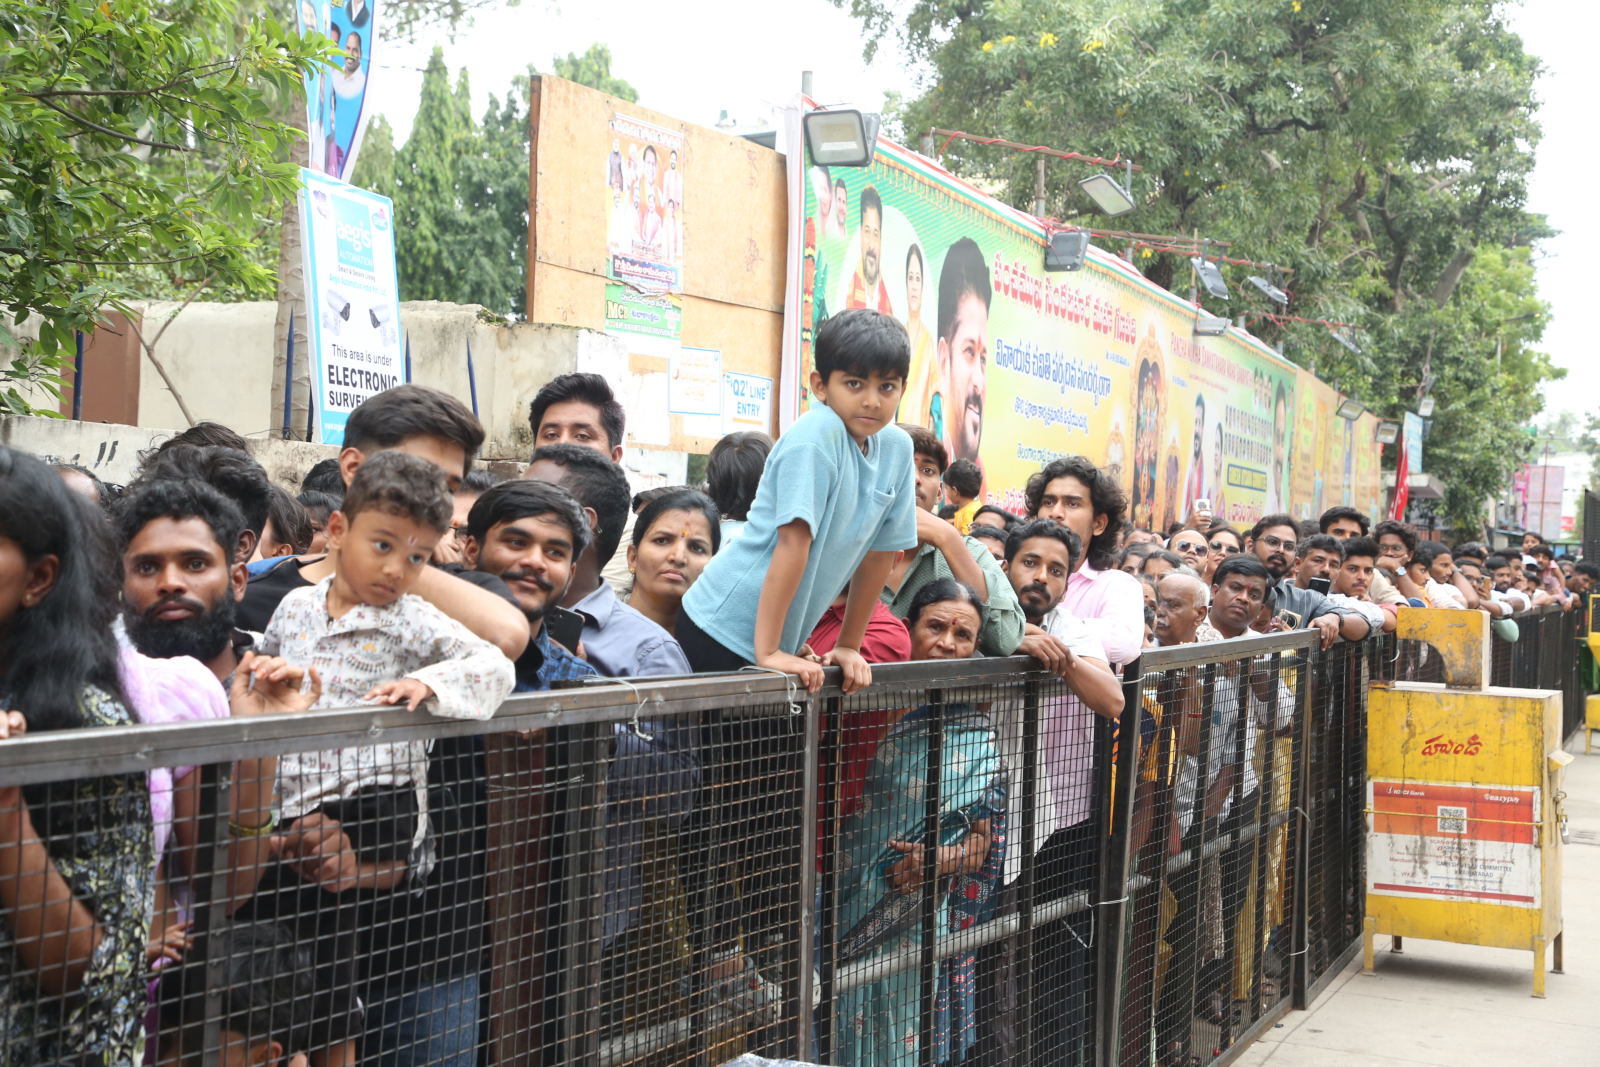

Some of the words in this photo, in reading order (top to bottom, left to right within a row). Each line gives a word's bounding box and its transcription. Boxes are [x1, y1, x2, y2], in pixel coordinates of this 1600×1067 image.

[336, 221, 372, 252] aegis
[332, 344, 348, 359] This
[349, 350, 364, 362] area
[365, 350, 372, 364] is
[373, 354, 392, 367] under
[328, 364, 398, 392] ELECTRONIC
[749, 386, 766, 401] LINE
[737, 401, 761, 417] ENTRY
